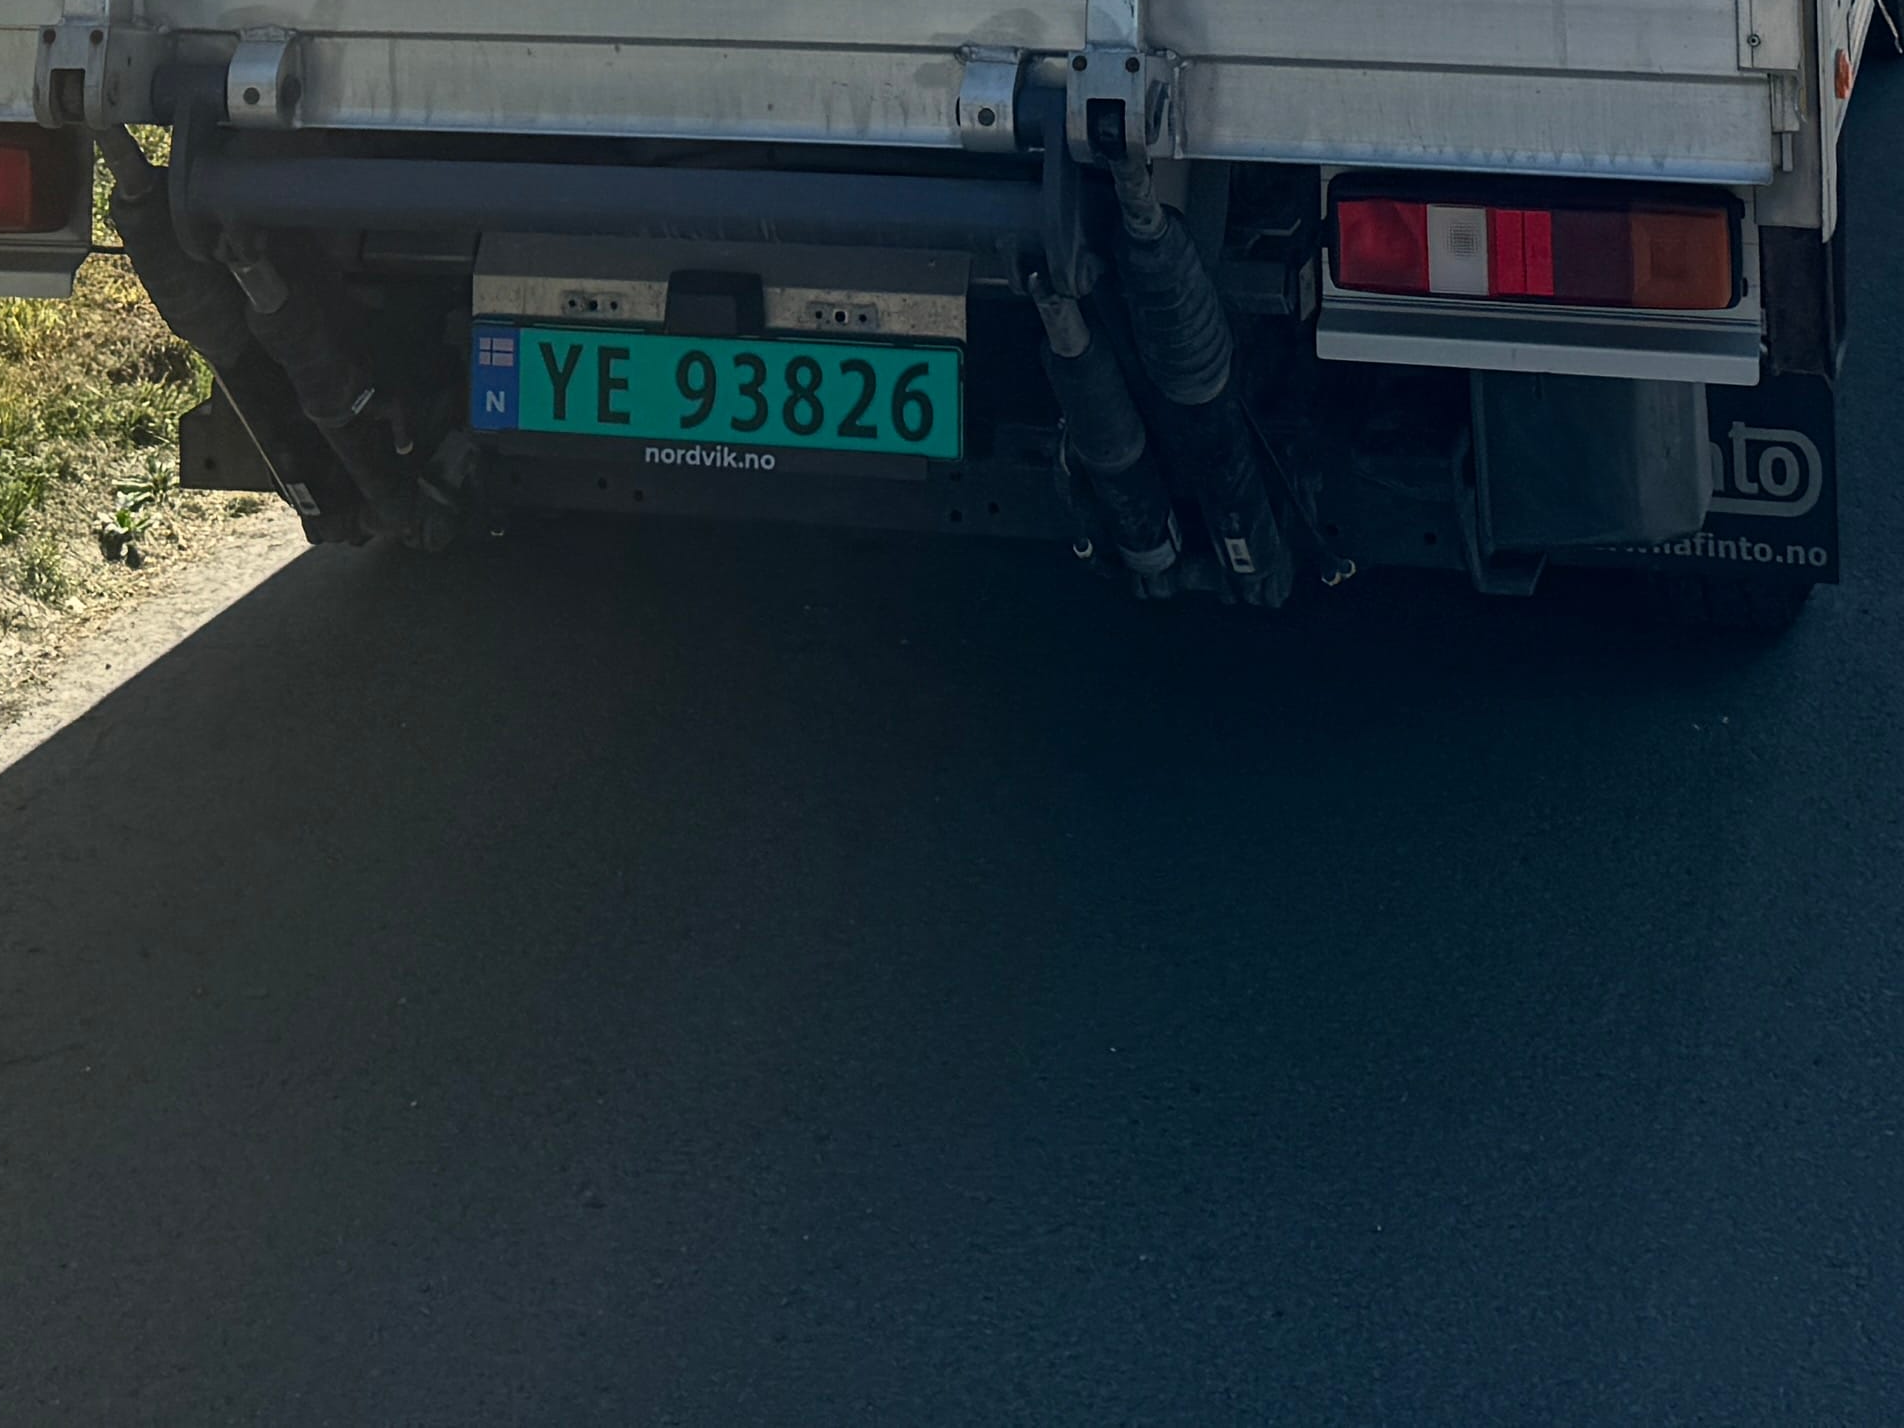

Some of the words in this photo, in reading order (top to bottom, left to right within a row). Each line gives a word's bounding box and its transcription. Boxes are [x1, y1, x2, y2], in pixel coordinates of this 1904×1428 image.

[486, 391, 505, 413] N
[538, 342, 631, 426] YE
[675, 349, 934, 443] 93826
[645, 445, 776, 471] nordvik.no
